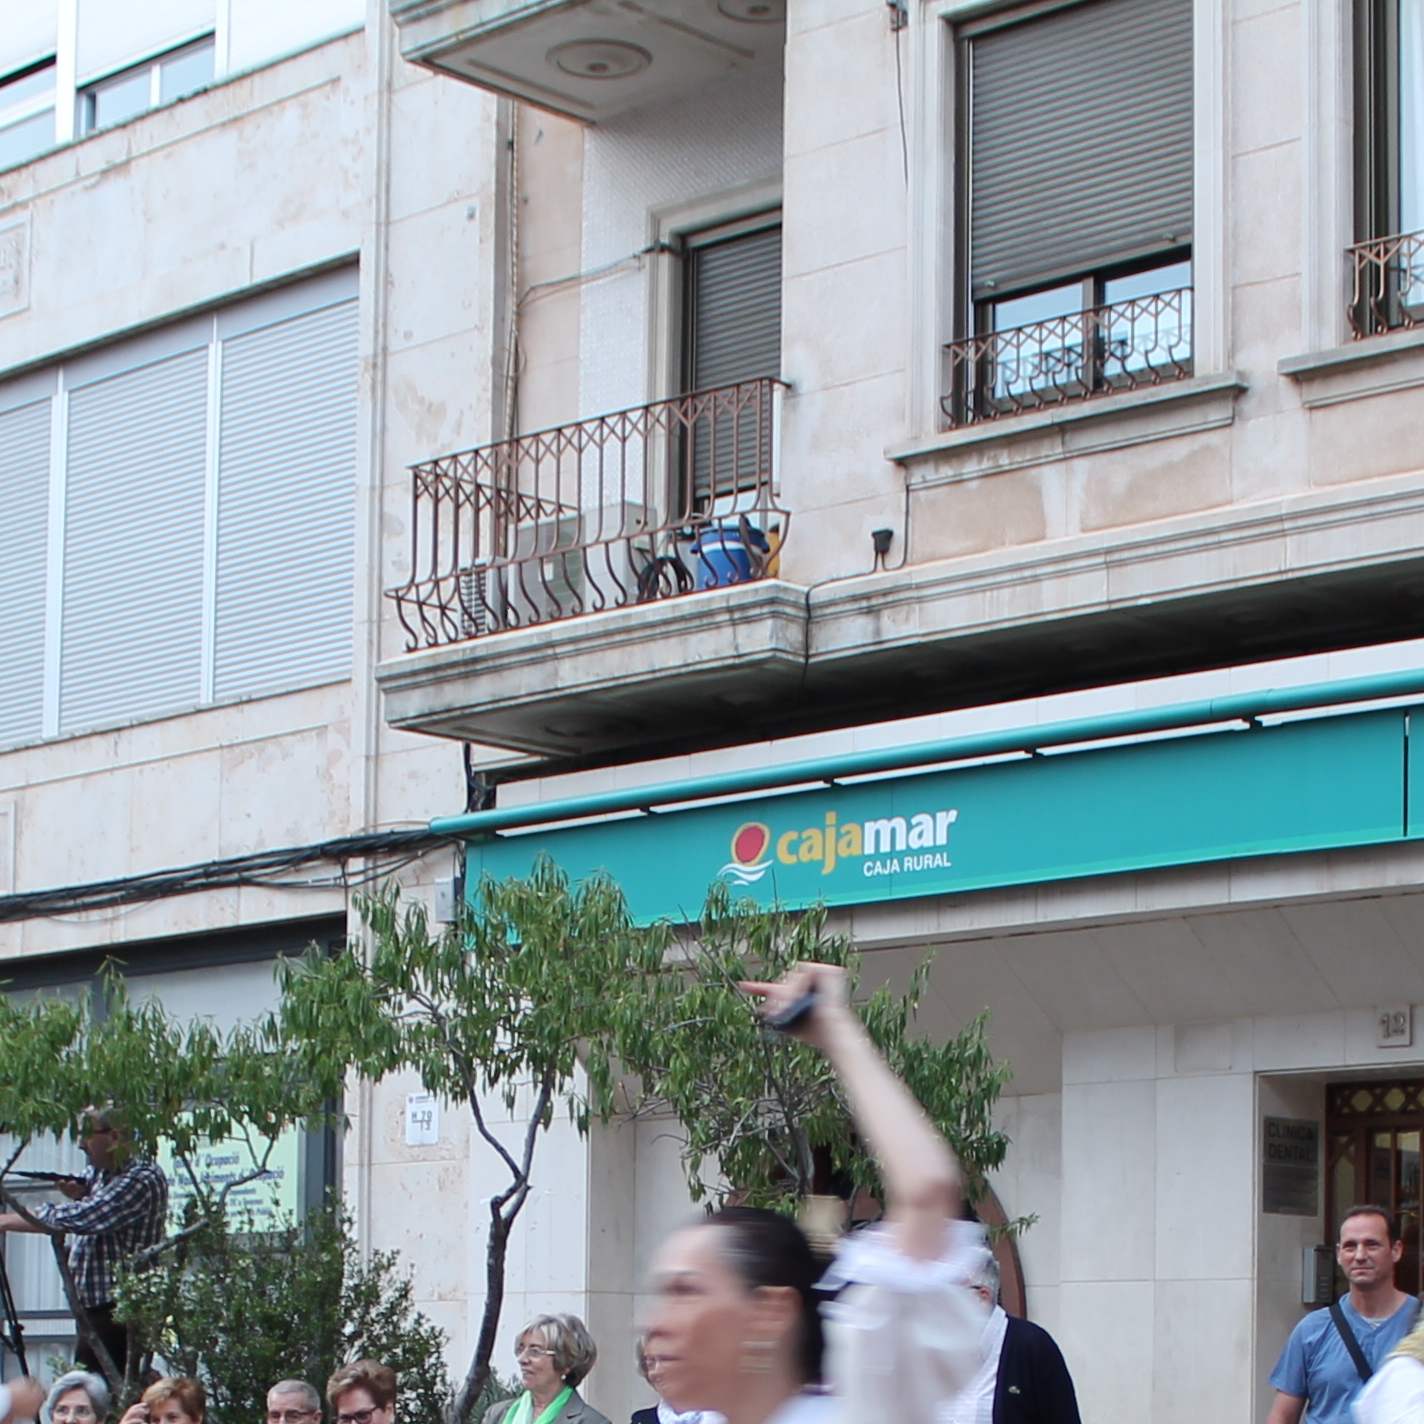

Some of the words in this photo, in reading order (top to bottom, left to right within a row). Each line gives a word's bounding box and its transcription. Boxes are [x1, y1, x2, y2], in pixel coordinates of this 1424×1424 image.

[777, 809, 958, 875] cajamar
[863, 860, 900, 877] CAJA
[903, 852, 951, 872] RURAL
[1380, 1013, 1405, 1038] 12
[1268, 1142, 1313, 1162] DENTAL
